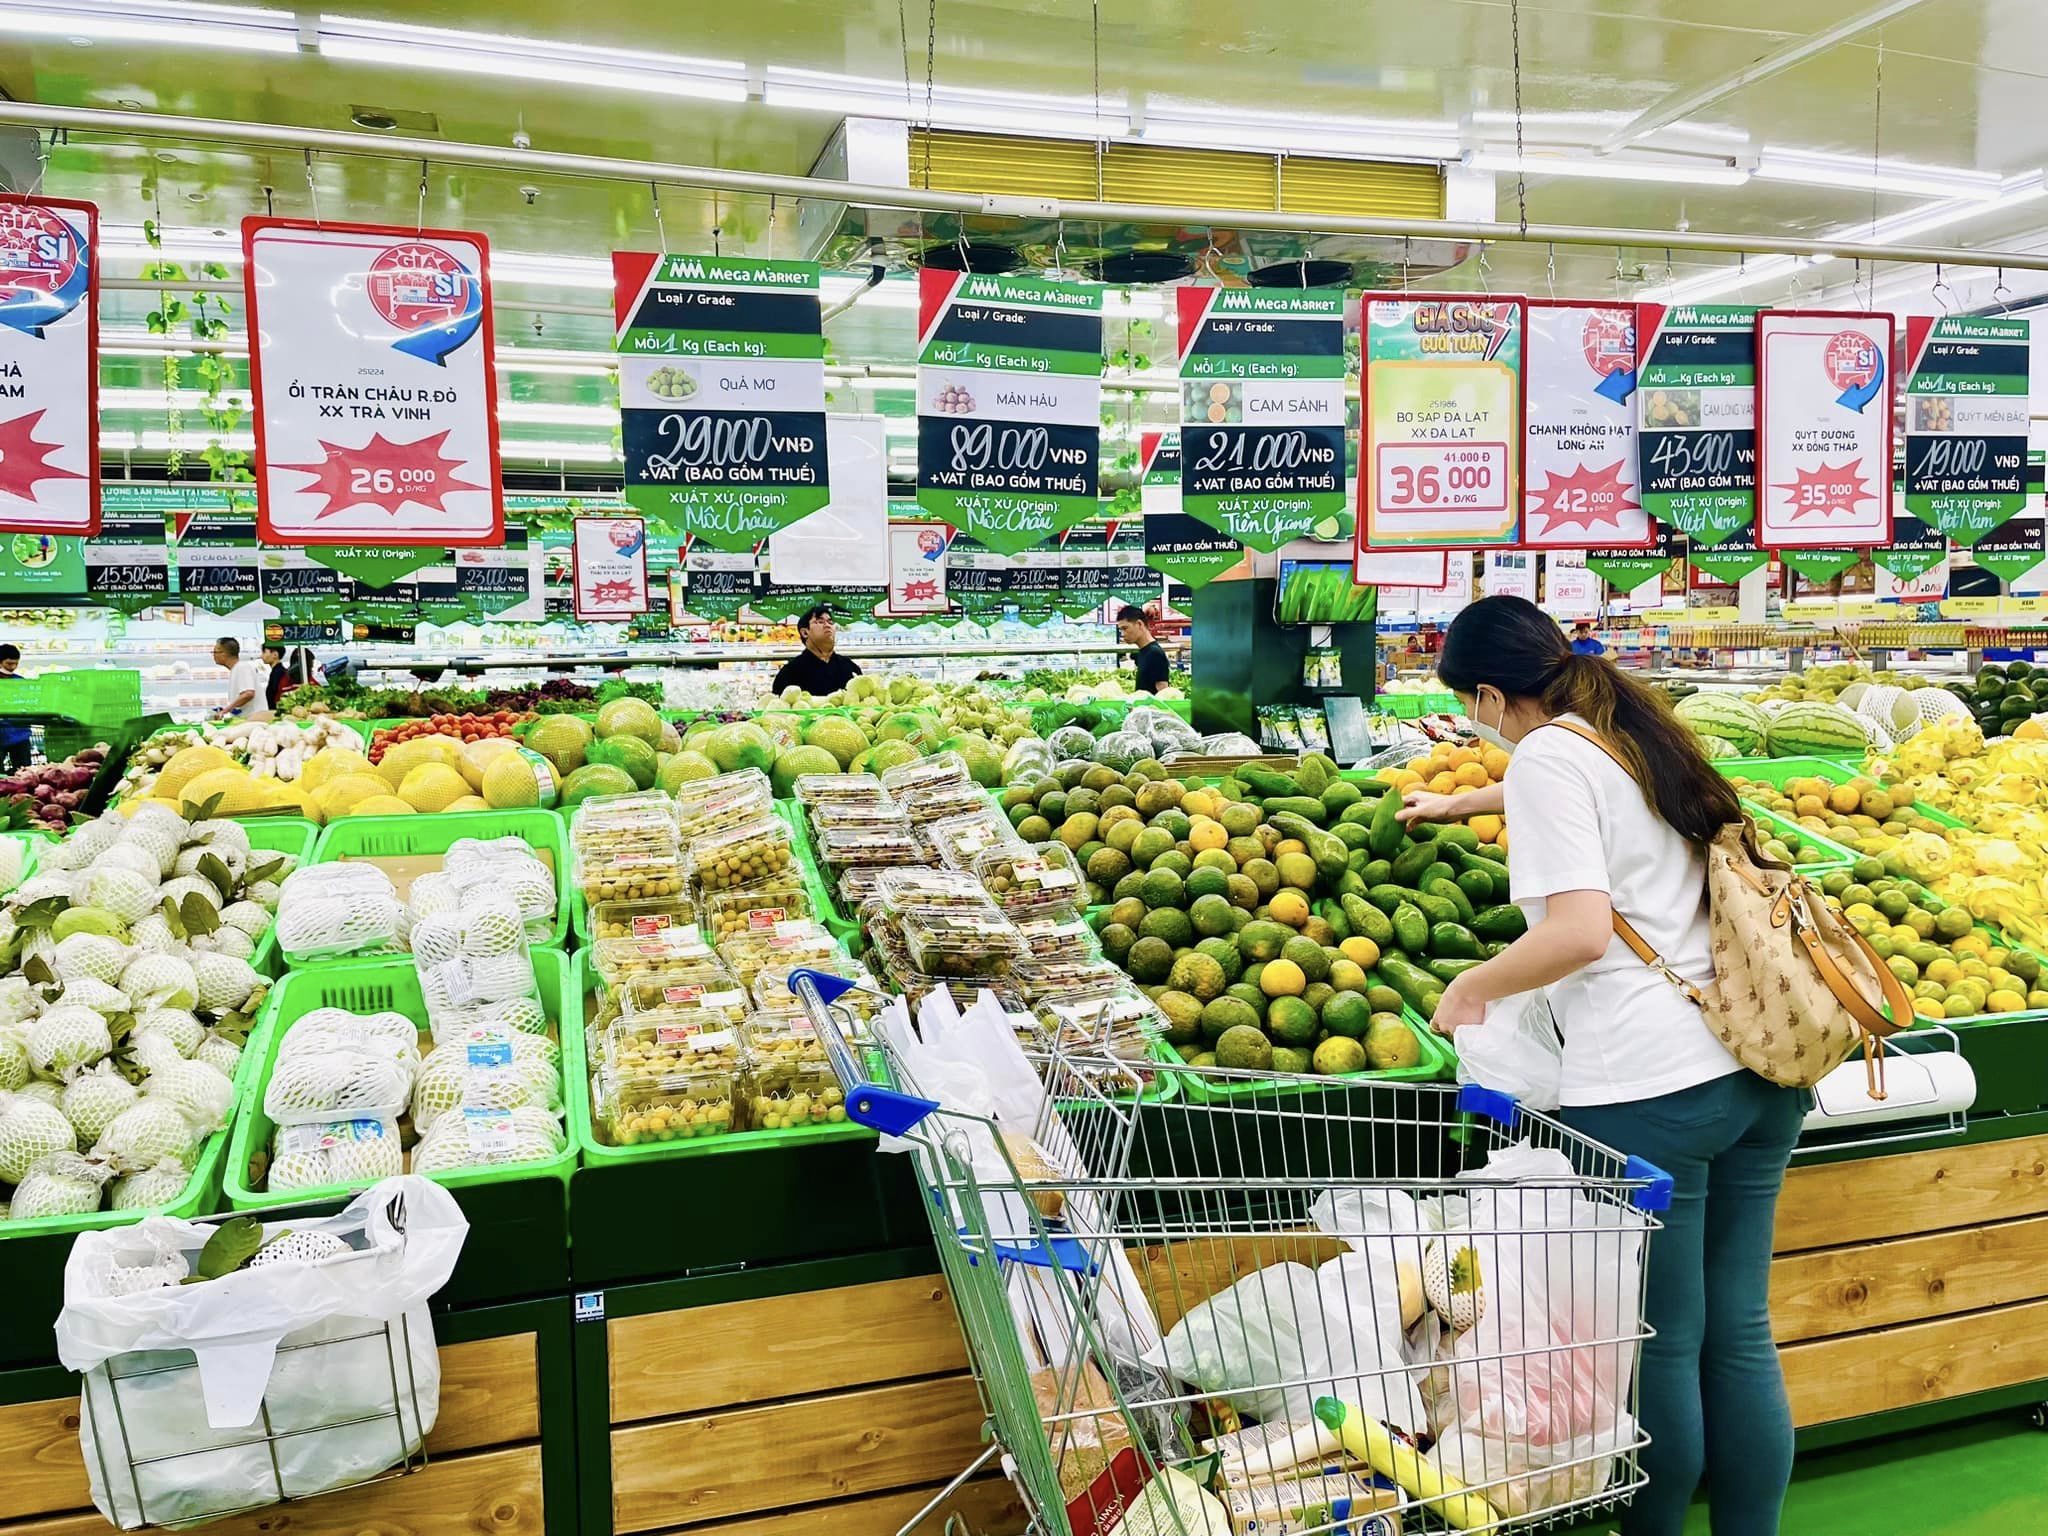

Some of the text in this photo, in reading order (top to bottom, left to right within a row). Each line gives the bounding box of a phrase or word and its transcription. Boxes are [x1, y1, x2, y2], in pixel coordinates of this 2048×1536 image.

[709, 267, 810, 284] Mega Market
[657, 292, 736, 306] Loại / Grade:
[1004, 288, 1094, 306] Mega Market
[1254, 298, 1335, 311] Mega Market
[957, 308, 980, 322] Loại
[992, 311, 1027, 324] Grade:
[1700, 313, 1728, 324] Mega
[1212, 321, 1275, 334] Loại Grade:
[1964, 326, 2024, 337] Mega Market
[635, 332, 659, 350] MỖI
[682, 340, 699, 354] Kg
[704, 340, 742, 354] (Each
[745, 342, 767, 356] kg):
[1665, 335, 1717, 346] Loại Grade:
[1932, 345, 1948, 356] Loại
[934, 345, 957, 362] MỖI
[976, 353, 991, 367] Kg
[995, 353, 1028, 368] (Each
[1031, 356, 1052, 371] kg):
[1193, 357, 1214, 374] MỖI
[1231, 364, 1245, 376] Kg
[1248, 363, 1278, 376] (Each
[1281, 364, 1300, 376] kg):
[1680, 373, 1692, 385] Kg
[1694, 372, 1719, 384] (Each
[311, 384, 359, 400] TRÂN
[365, 385, 412, 402] CHÂU
[1945, 382, 1957, 392] Kg
[1958, 381, 1981, 392] (Each
[319, 405, 344, 418] XX
[392, 408, 431, 420] VINH
[1249, 399, 1284, 412] CAM
[1411, 428, 1427, 438] XX
[1528, 424, 1567, 436] CHANH
[1569, 422, 1606, 435] KHÔNG
[772, 437, 814, 453] VNĐ
[1557, 439, 1586, 450] LONG
[1792, 443, 1803, 451] XX
[1050, 448, 1088, 464] VNĐ
[1302, 448, 1335, 463] VNĐ
[1443, 452, 1491, 463] 41.000 Đ
[1994, 455, 2020, 468] VNĐ
[639, 462, 815, 484] +VAT (BAO GỒM THUẾ)
[930, 471, 1087, 494] +VAT (BAO GỒM THUẾ)
[1193, 471, 1335, 492] +VAT (BAO GỒM THUẾ)
[1651, 471, 1732, 491] +VAT (BAO GỒM
[1914, 475, 2020, 492] +VAT (BAO GỒM THUẾ)
[669, 488, 788, 507] XUẤT XỨ (Origin):
[955, 492, 1060, 514] XUẤT XỨ (Origin):
[1217, 496, 1312, 512] XUẤT XỨ (Origin):
[1453, 495, 1478, 503] Đ/KG
[1698, 496, 1712, 507] XỨ
[1715, 497, 1748, 509] (Origin):
[1972, 499, 2001, 511] (Origin):
[382, 549, 417, 560] (Origin):
